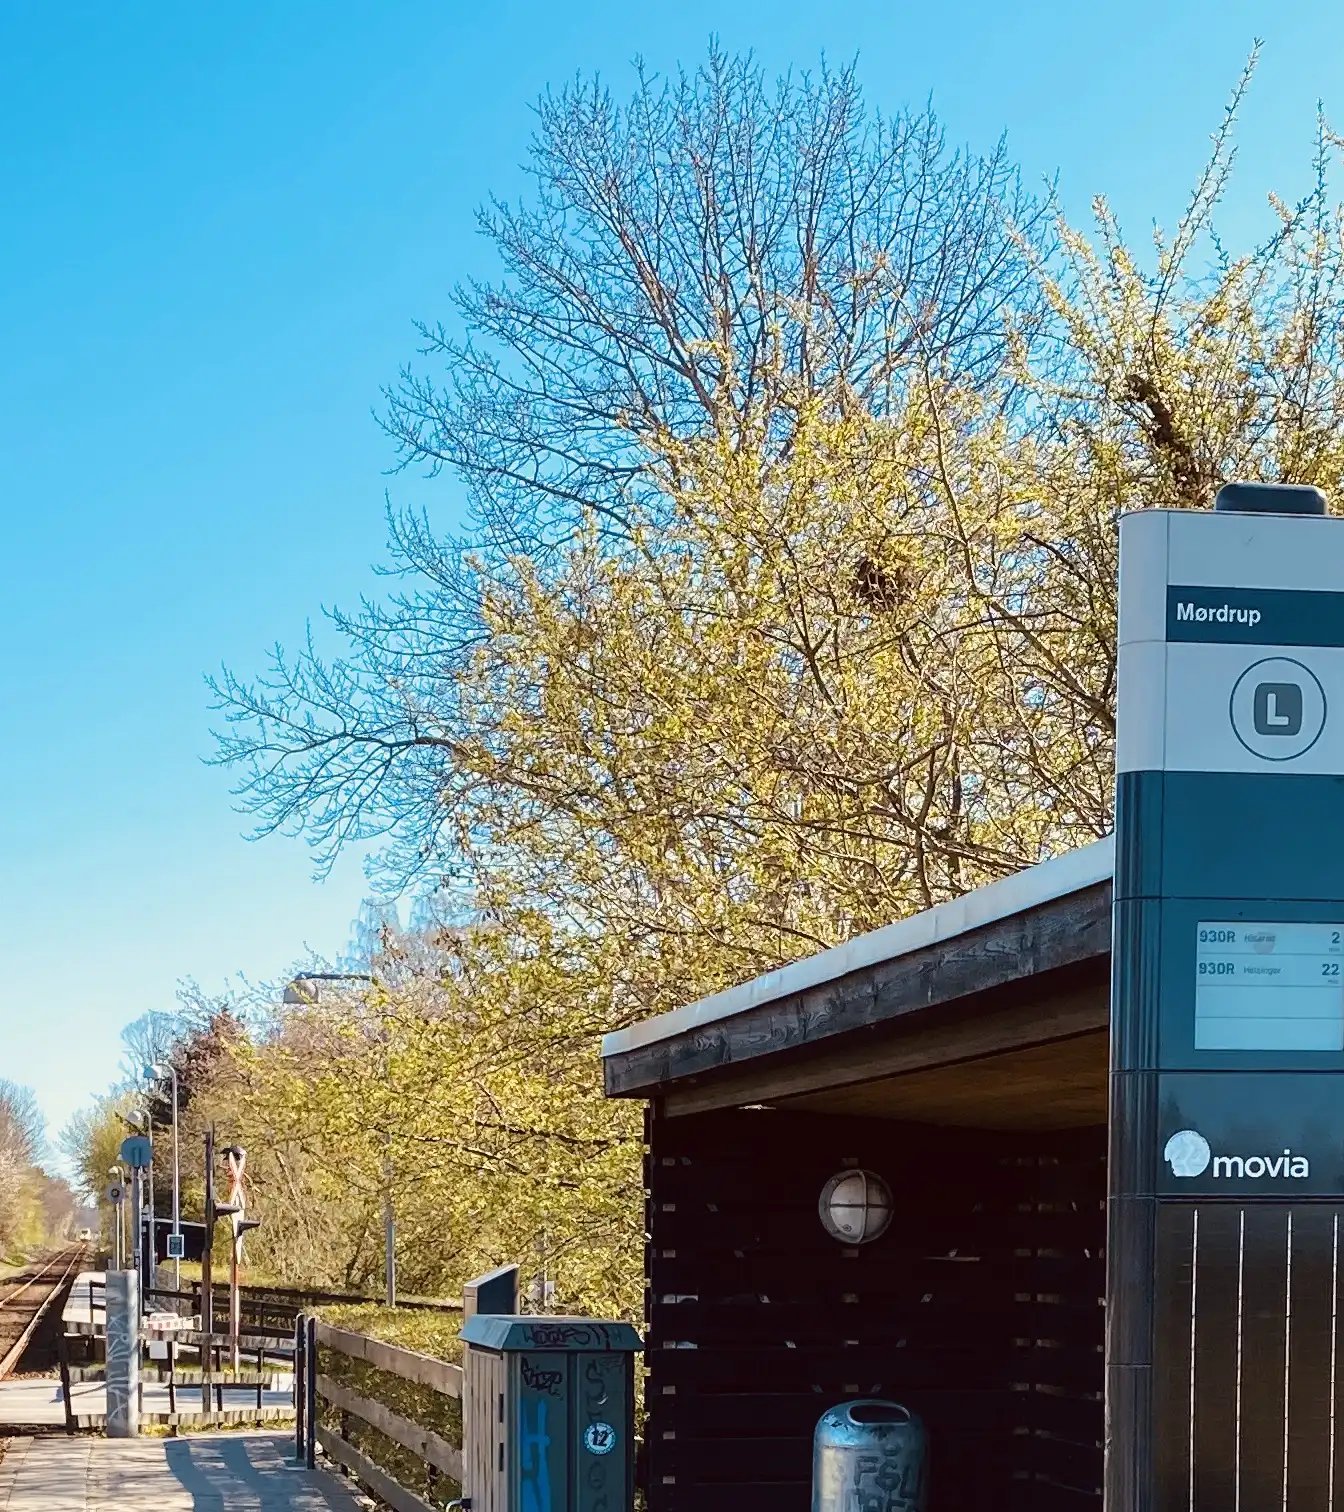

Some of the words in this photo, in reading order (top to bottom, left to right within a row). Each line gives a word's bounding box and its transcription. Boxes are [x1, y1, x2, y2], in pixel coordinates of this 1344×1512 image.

[1176, 602, 1262, 626] Mørdrup
[1266, 692, 1290, 727] L
[1199, 930, 1236, 943] 930R
[1331, 931, 1341, 944] 2
[1198, 962, 1235, 975] 930R
[1321, 963, 1341, 976] 22
[1212, 1149, 1309, 1178] movia
